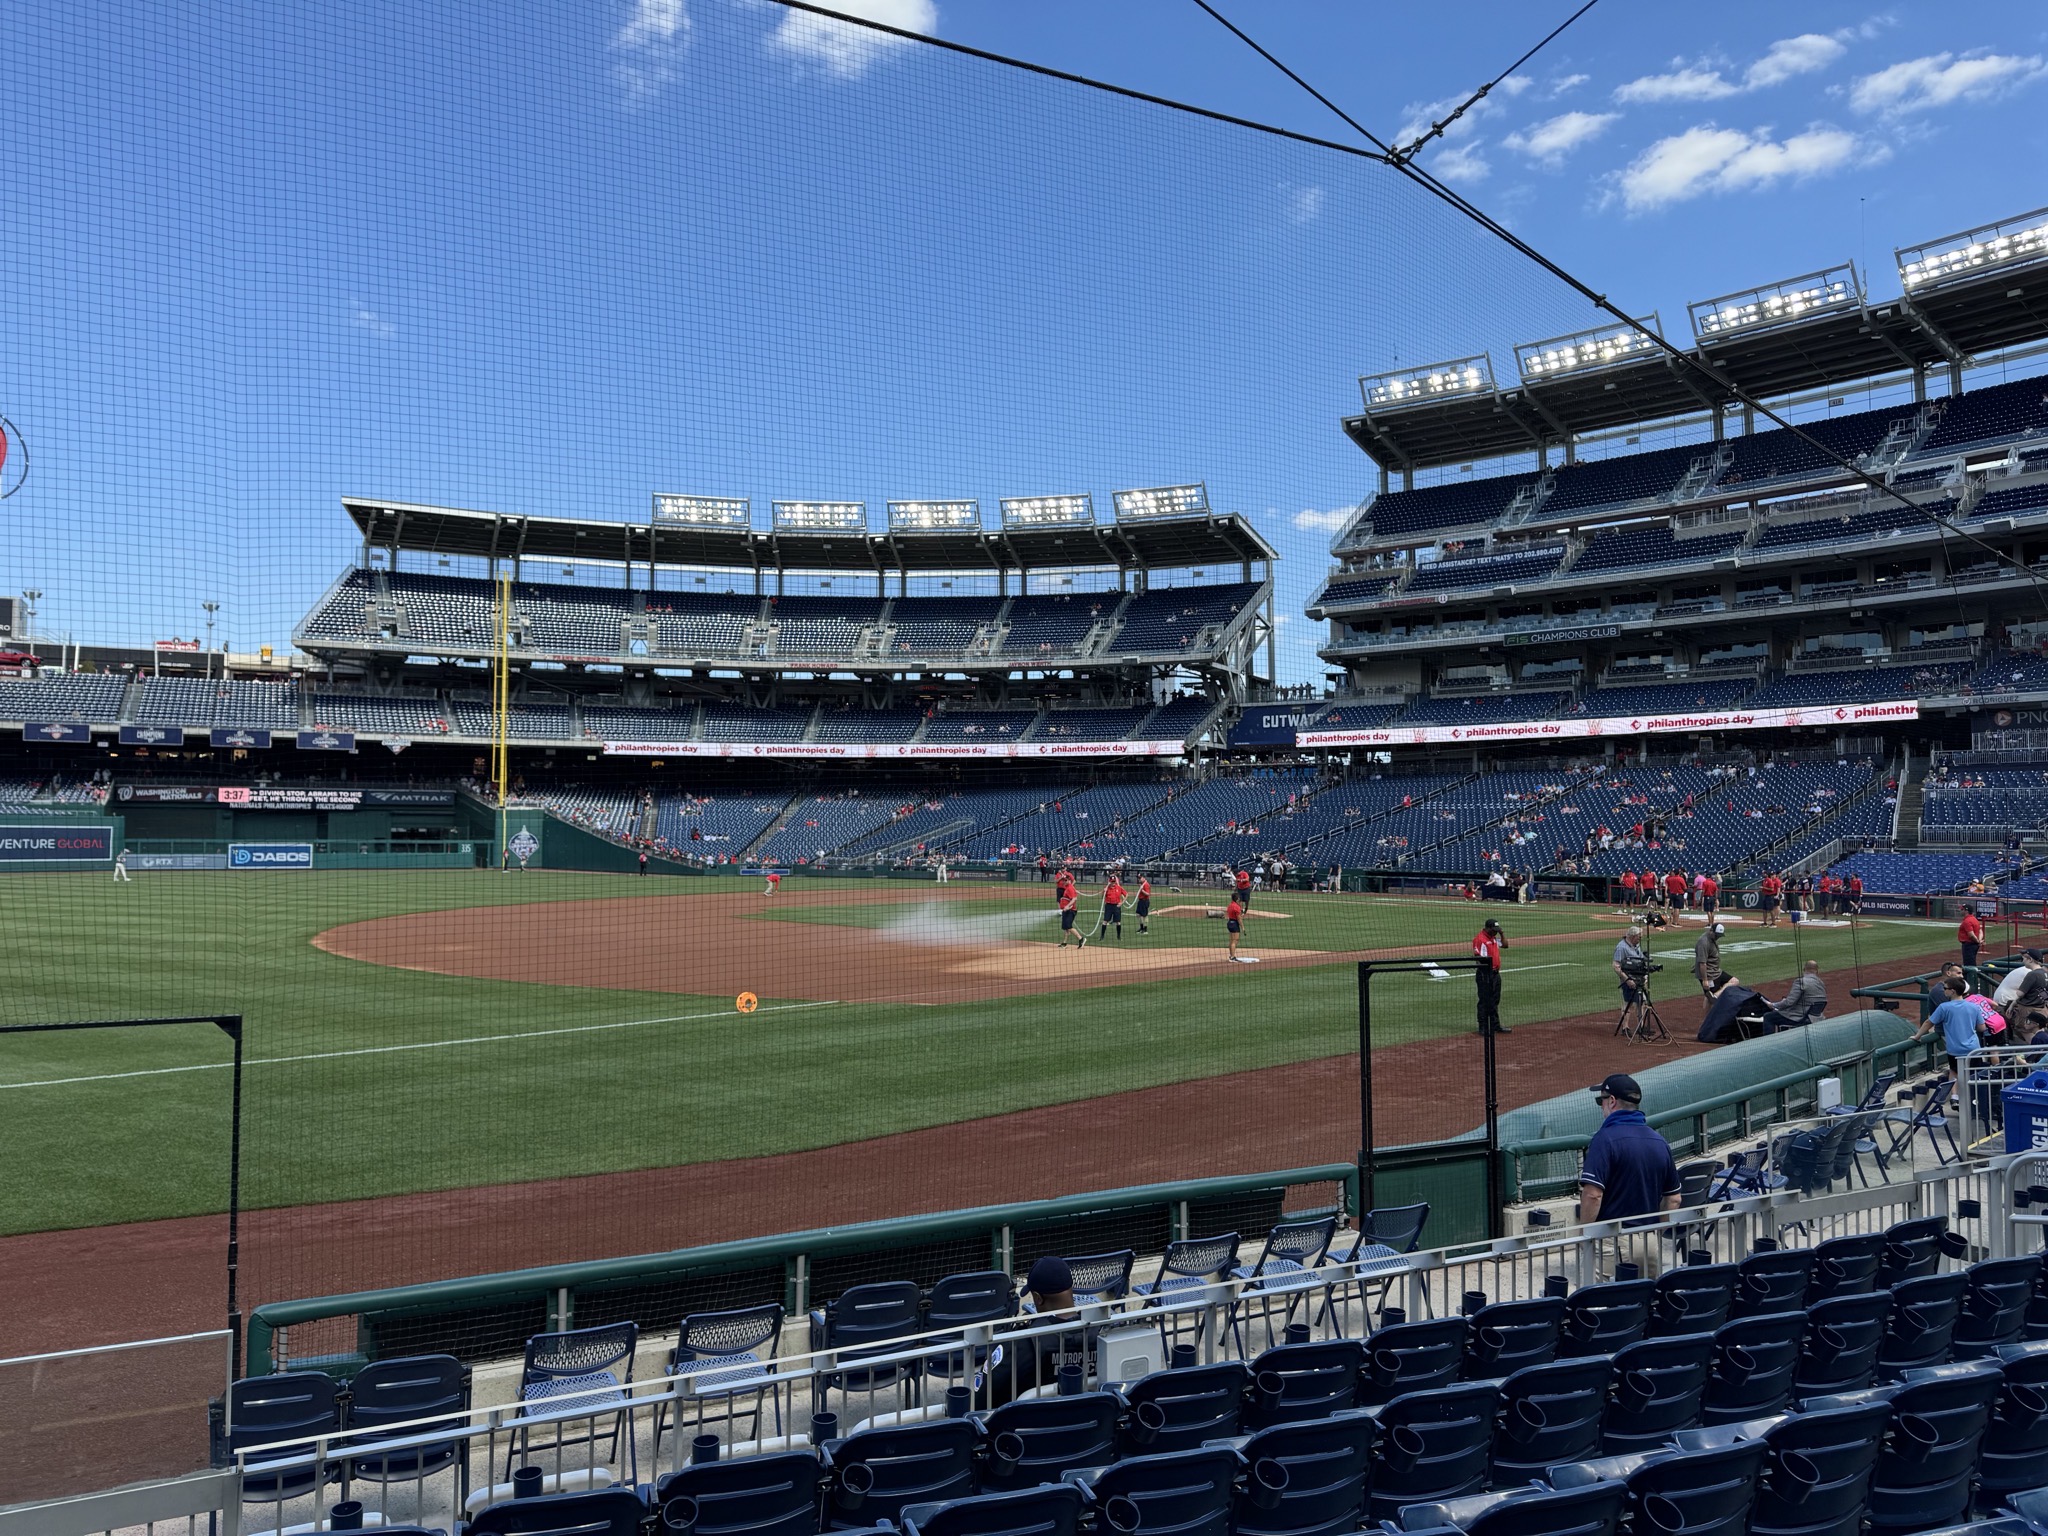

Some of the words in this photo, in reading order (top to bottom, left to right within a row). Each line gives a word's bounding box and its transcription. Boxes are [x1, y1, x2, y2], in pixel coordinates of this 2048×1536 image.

[1438, 559, 1475, 568] ASSISTANCE?
[1531, 629, 1588, 643] CHAMPIONS
[1590, 627, 1617, 637] CLUB
[1972, 696, 2019, 705] RODRIGUEZ
[1646, 716, 1729, 729] philanthropies
[1732, 715, 1754, 724] day
[136, 730, 165, 740] CHAMPIONS
[1466, 726, 1539, 737] philanthropies
[1542, 725, 1561, 733] day
[1306, 733, 1370, 744] philanthropies
[1372, 732, 1390, 741] day
[614, 745, 680, 753] philanthropies
[682, 745, 698, 753] day
[1052, 745, 1109, 754] philanthropies
[1112, 744, 1128, 752] day
[136, 788, 187, 797] WASHINGTON
[160, 792, 202, 801] NATIONALS
[224, 791, 243, 800] 3:37
[263, 802, 311, 810] PHILANTHROPIES
[0, 838, 56, 849] VENTURE
[57, 839, 104, 849] GLOBAL
[461, 843, 472, 853] 335
[252, 852, 310, 862] DABOS
[1862, 901, 1876, 909] MLB
[1877, 902, 1910, 910] NETWORK
[1051, 1350, 1098, 1365] MTROPLIT
